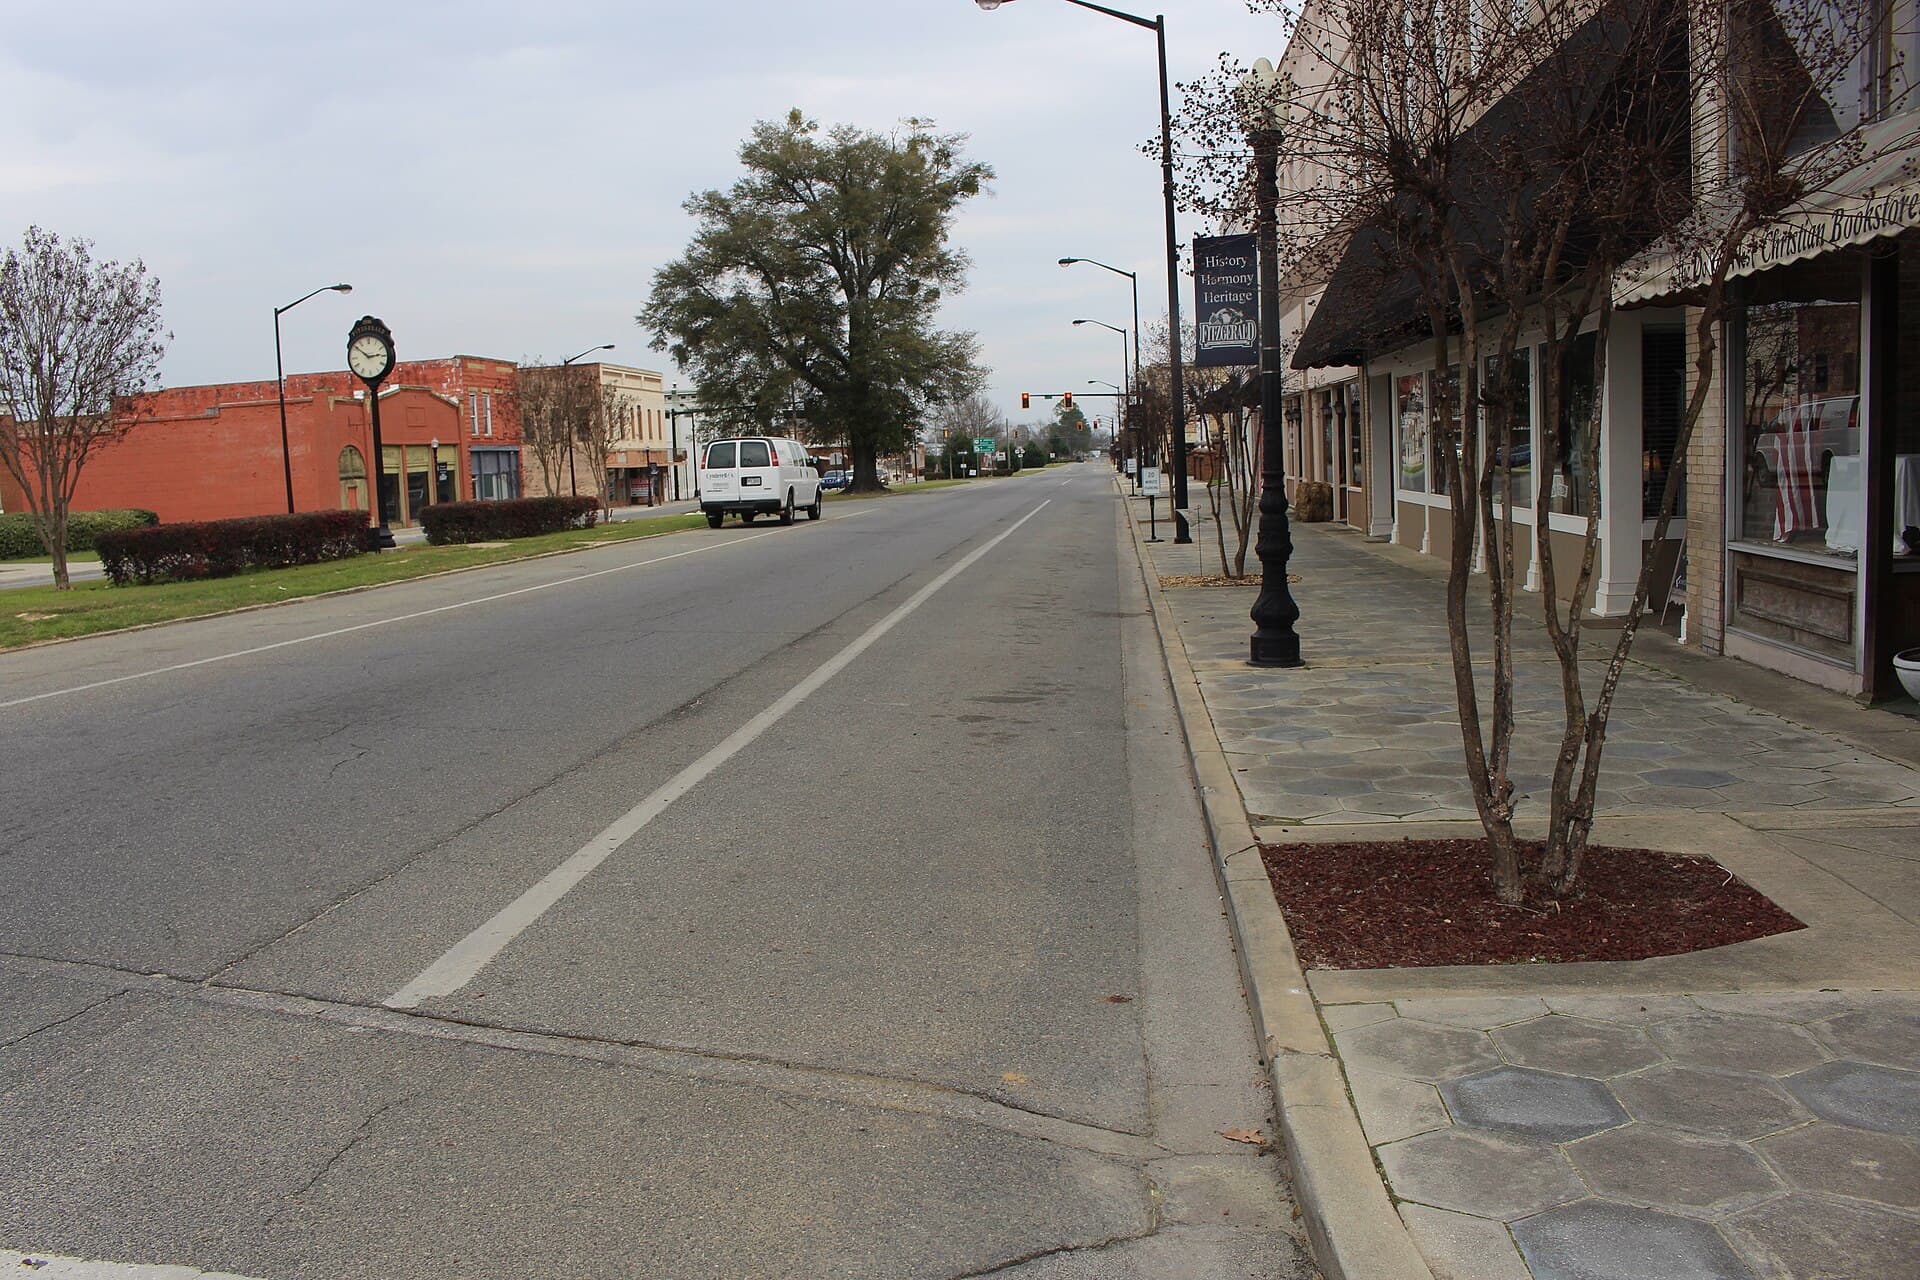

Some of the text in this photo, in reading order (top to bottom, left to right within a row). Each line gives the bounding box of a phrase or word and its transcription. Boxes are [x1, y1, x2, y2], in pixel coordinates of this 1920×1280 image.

[1761, 220, 1827, 263] Christian
[1829, 192, 1919, 244] Bookstore
[1205, 255, 1246, 268] History
[1200, 273, 1254, 286] Harmony
[1204, 290, 1253, 304] Heritage
[1201, 322, 1256, 343] FITZGERALD
